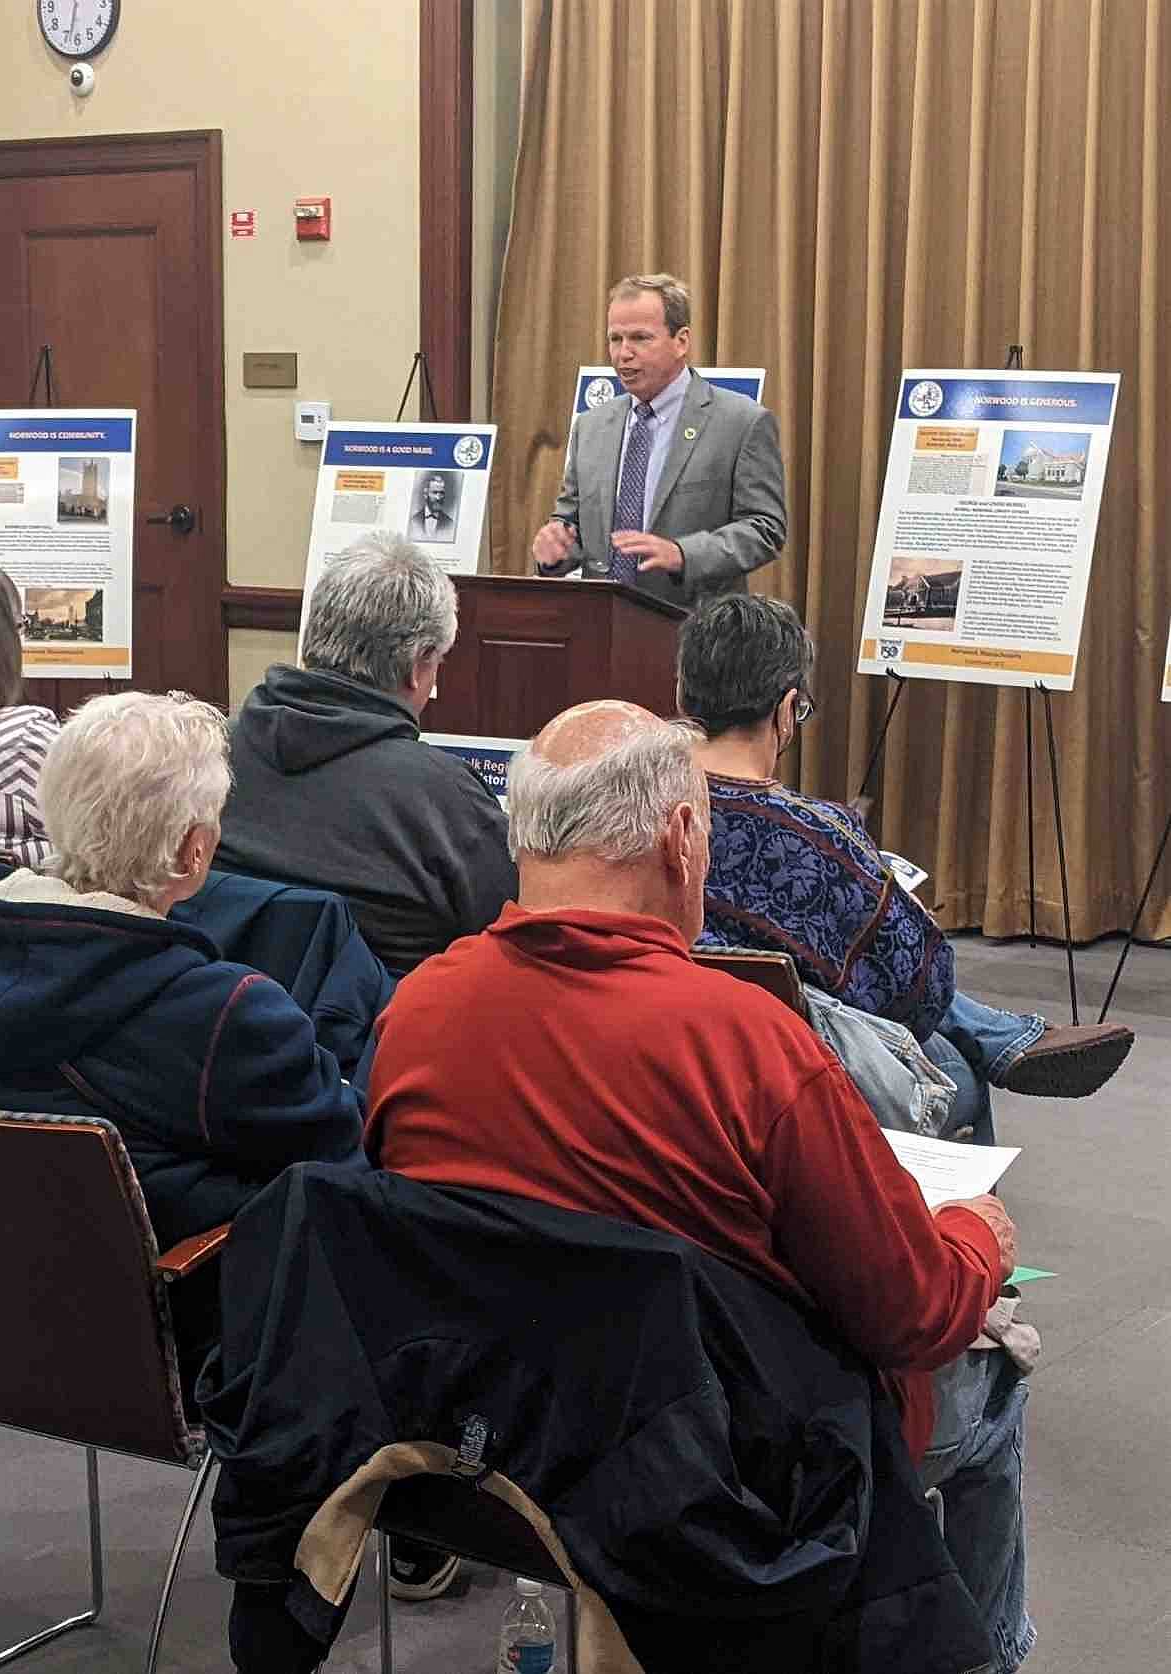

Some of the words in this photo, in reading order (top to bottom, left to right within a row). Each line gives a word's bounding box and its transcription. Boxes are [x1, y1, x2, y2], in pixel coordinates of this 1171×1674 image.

[48, 1, 54, 13] 9
[51, 18, 58, 31] 8
[95, 14, 103, 27] 4
[63, 30, 69, 43] 7
[74, 33, 81, 46] 6
[86, 28, 94, 40] 5
